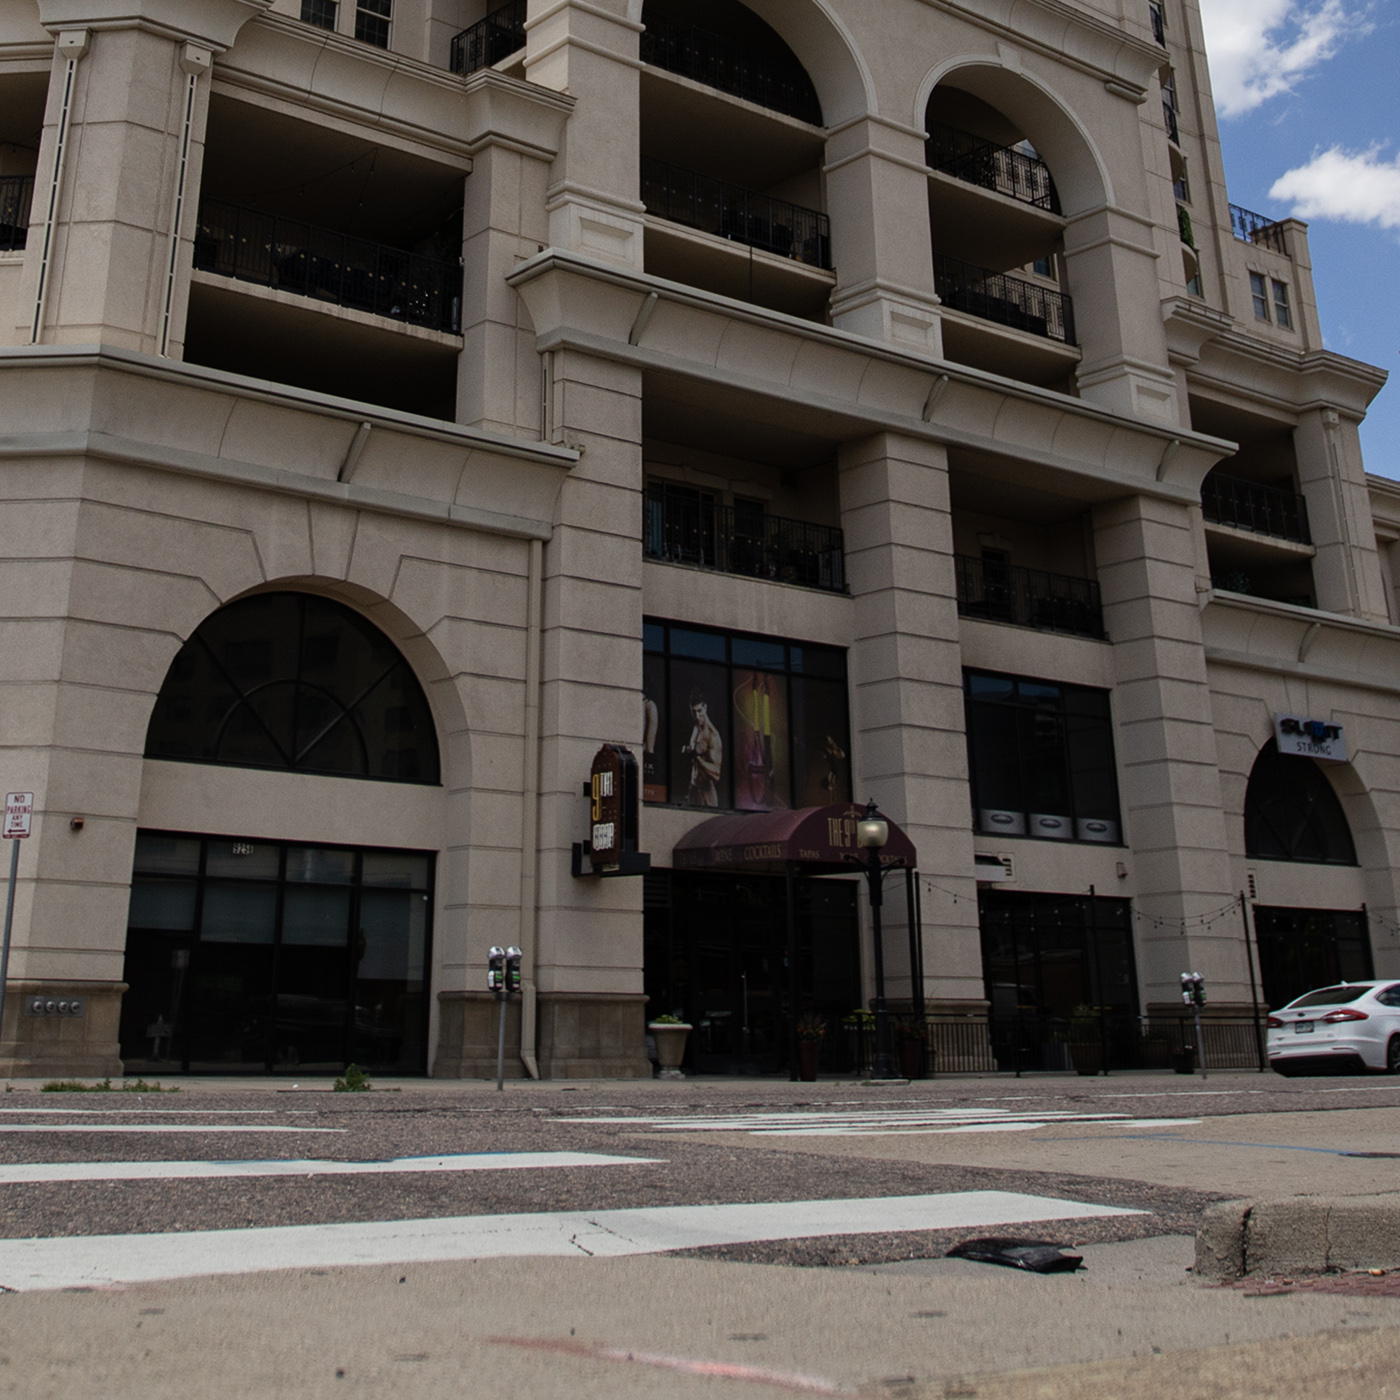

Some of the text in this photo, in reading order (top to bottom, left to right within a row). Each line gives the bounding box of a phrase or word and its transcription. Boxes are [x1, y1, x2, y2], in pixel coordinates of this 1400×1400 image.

[1296, 741, 1332, 756] STRONG
[13, 794, 25, 803] NO
[6, 805, 31, 814] PARKING
[827, 817, 843, 847] THE
[743, 843, 782, 860] COCKTAILS
[799, 848, 820, 859] TAPAS
